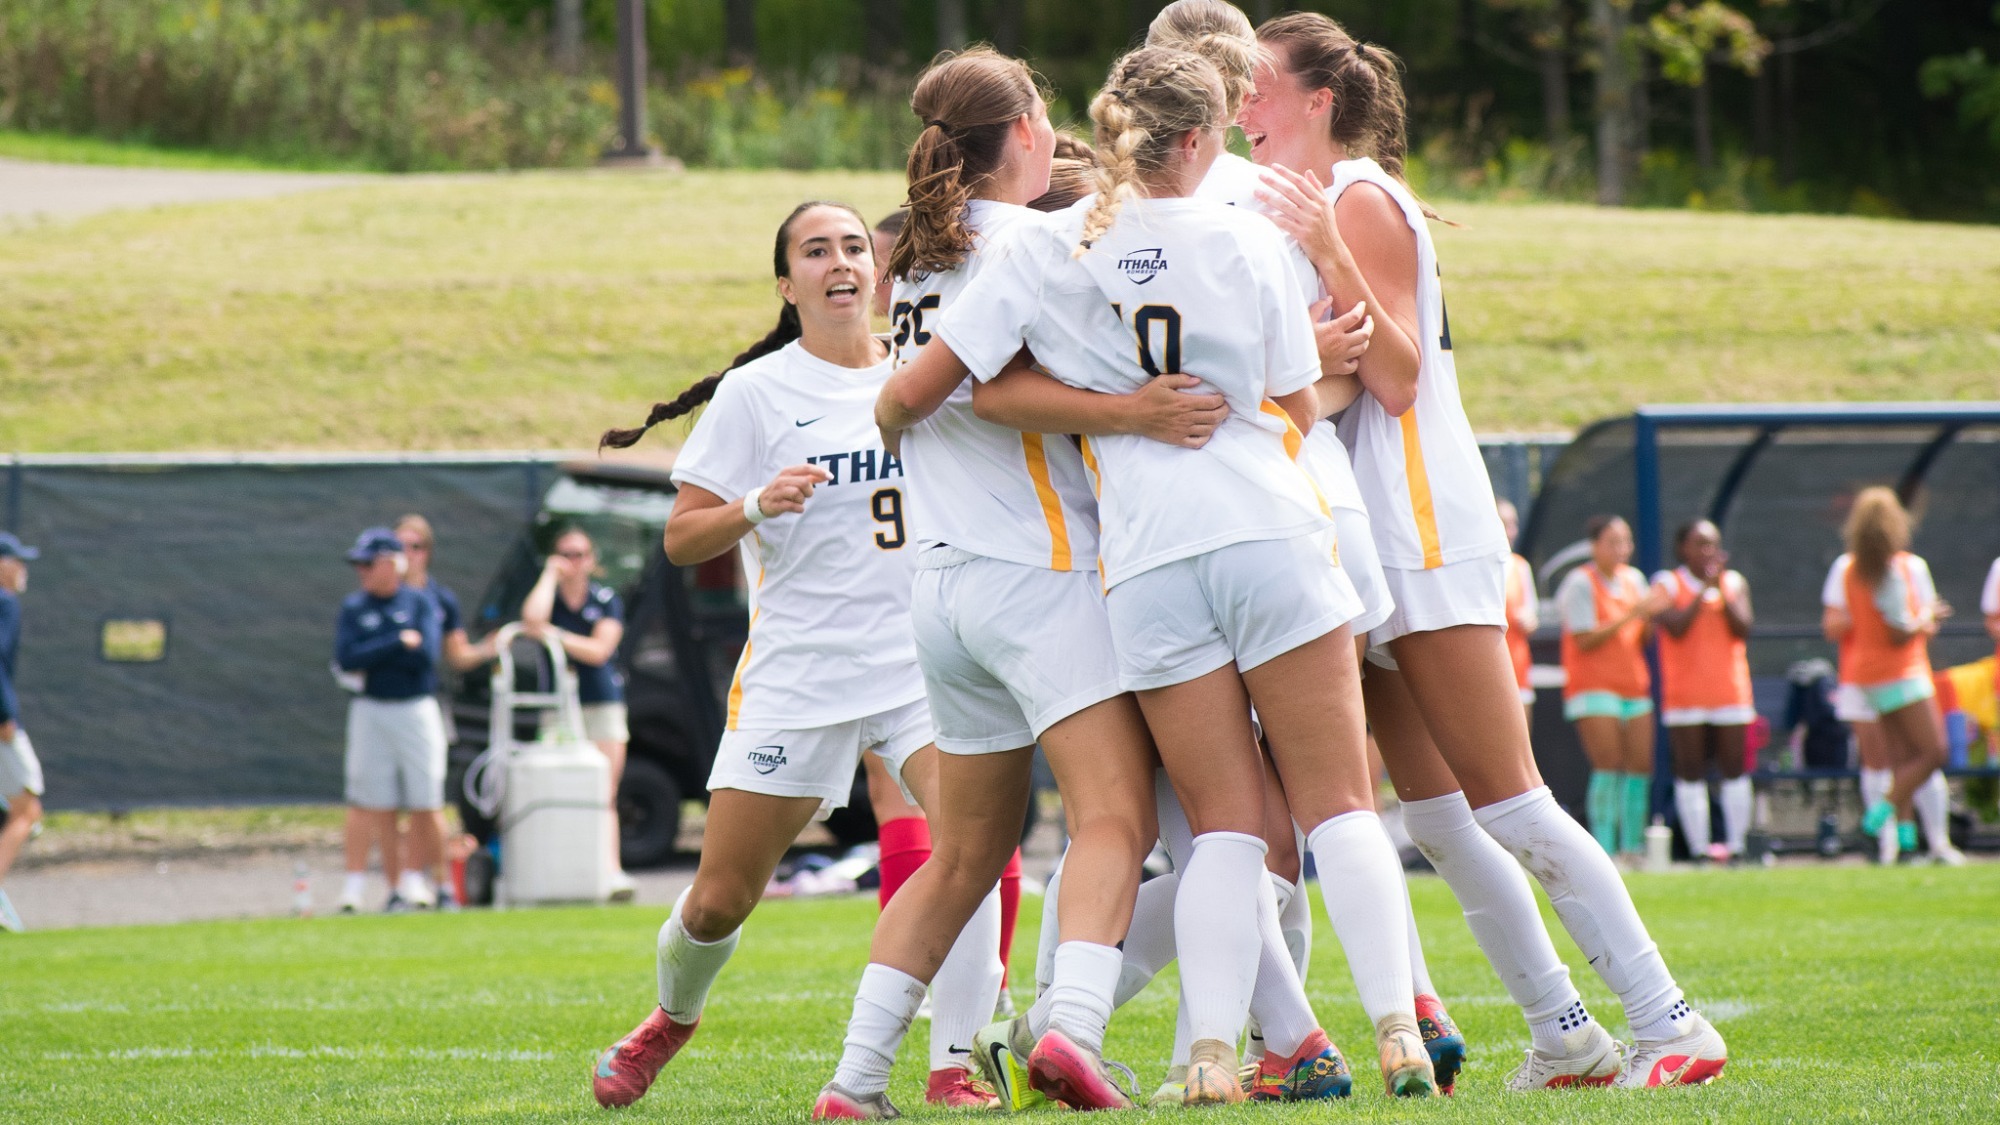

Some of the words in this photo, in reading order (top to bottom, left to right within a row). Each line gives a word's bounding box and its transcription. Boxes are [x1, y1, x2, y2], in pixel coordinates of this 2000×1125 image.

[1117, 259, 1167, 270] ITHACA
[1109, 302, 1182, 378] 0
[869, 486, 907, 551] 9
[747, 752, 786, 765] ITHACA
